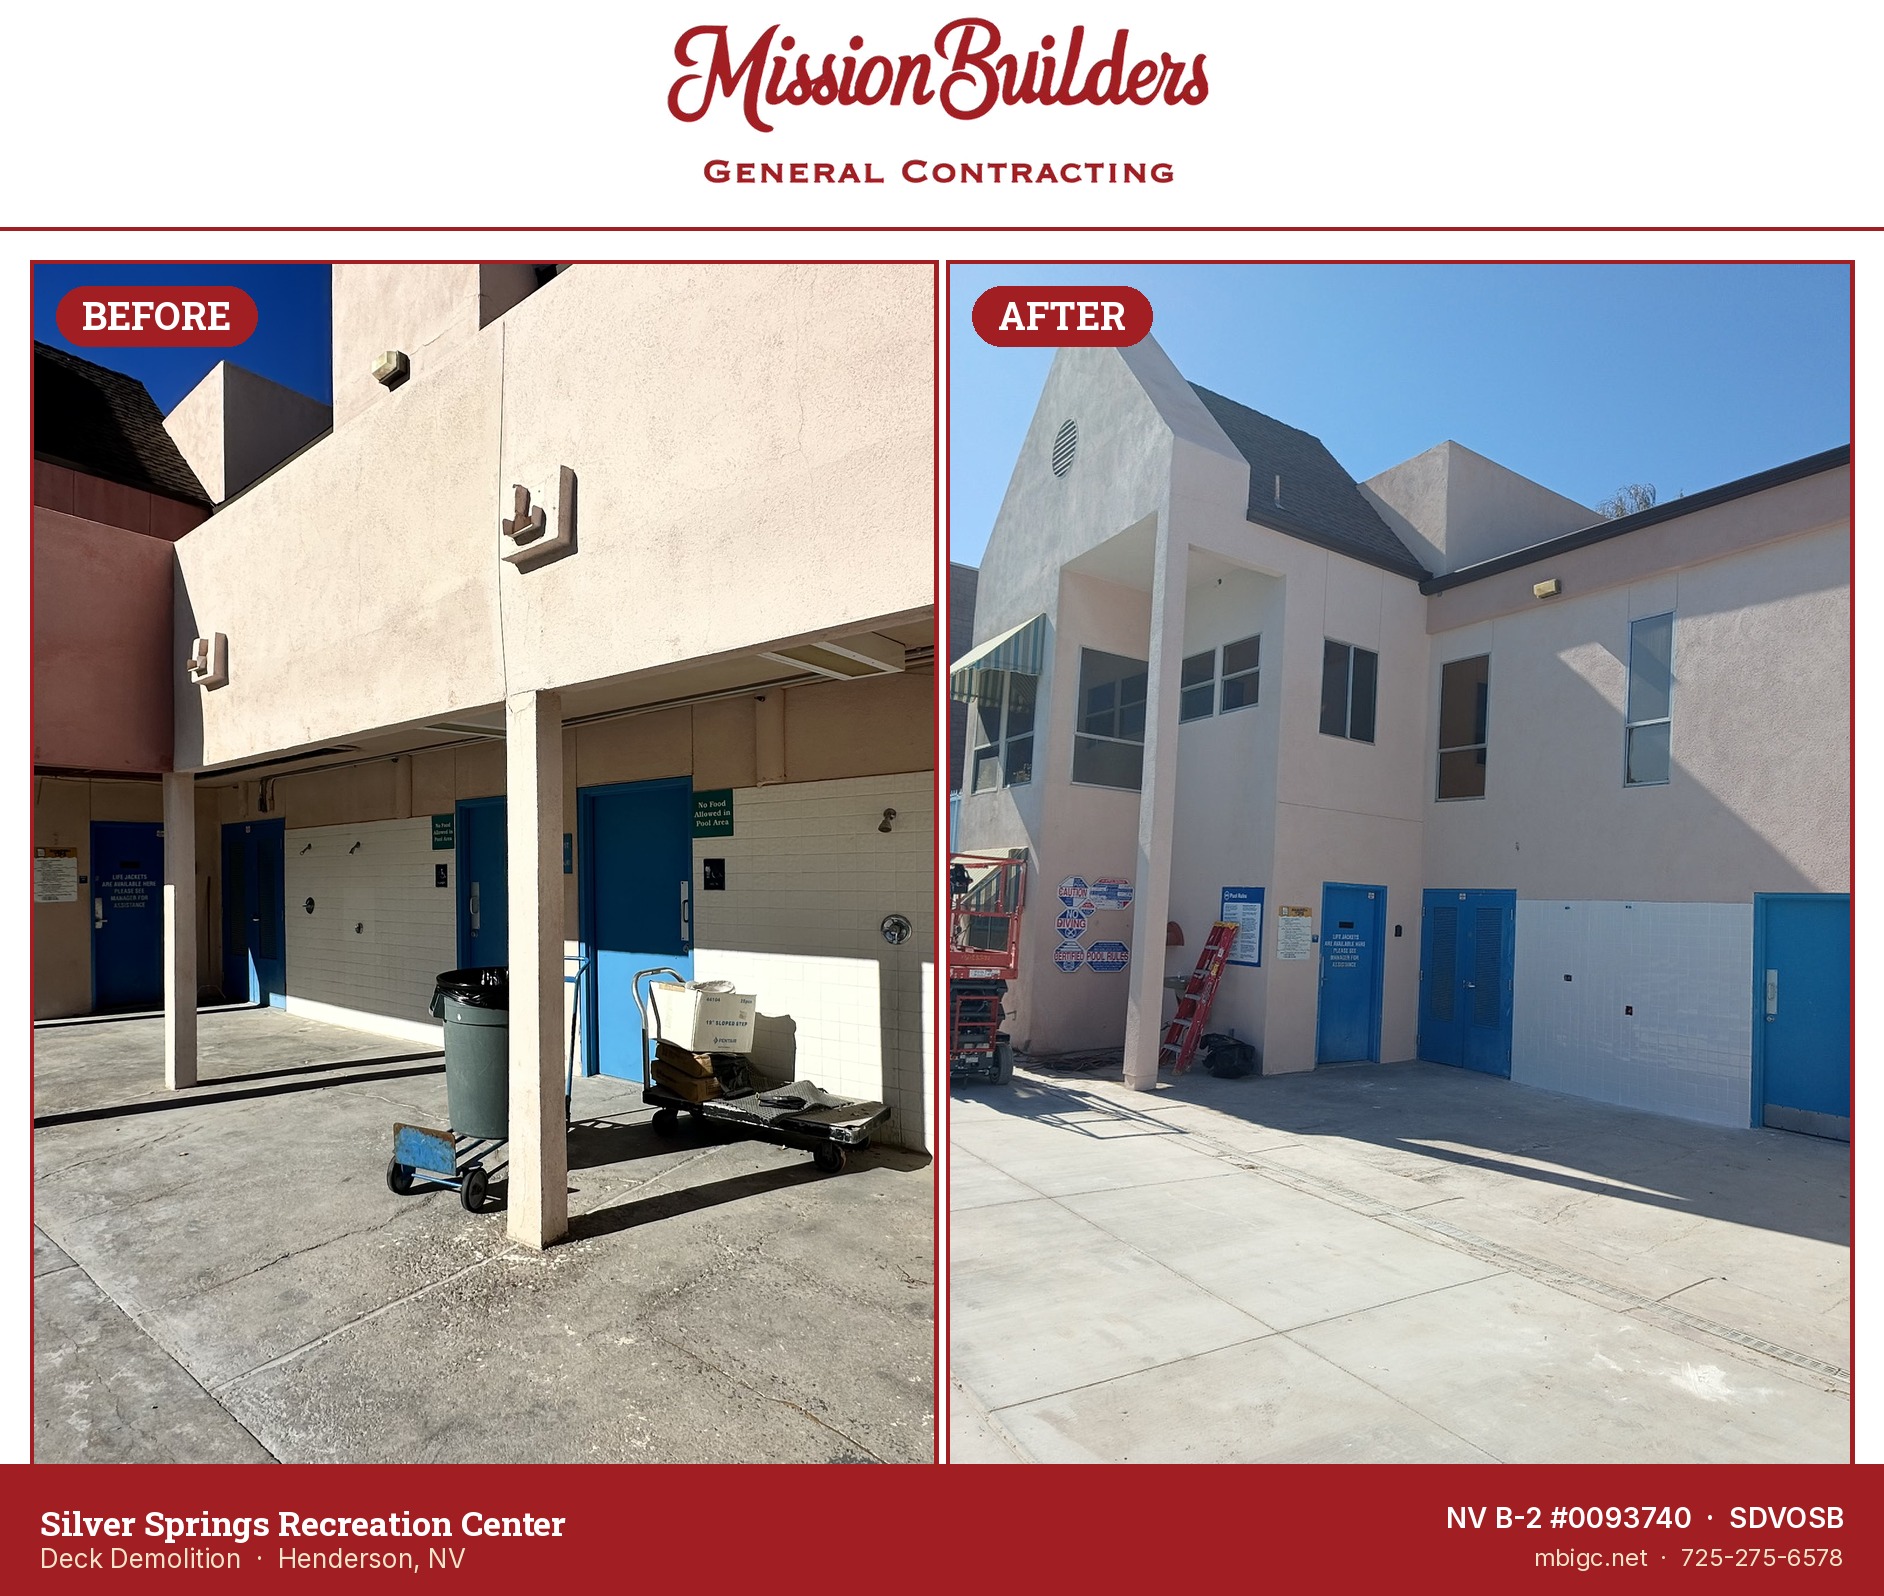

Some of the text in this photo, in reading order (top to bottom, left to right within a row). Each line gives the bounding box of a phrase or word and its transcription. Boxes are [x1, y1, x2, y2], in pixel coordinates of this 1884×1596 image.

[709, 800, 726, 808] Food
[694, 810, 721, 818] Allowed
[1058, 887, 1088, 897] CAUTION
[1066, 910, 1079, 919] NO
[1056, 919, 1086, 928] DIVING
[1086, 951, 1129, 961] POOL RULES
